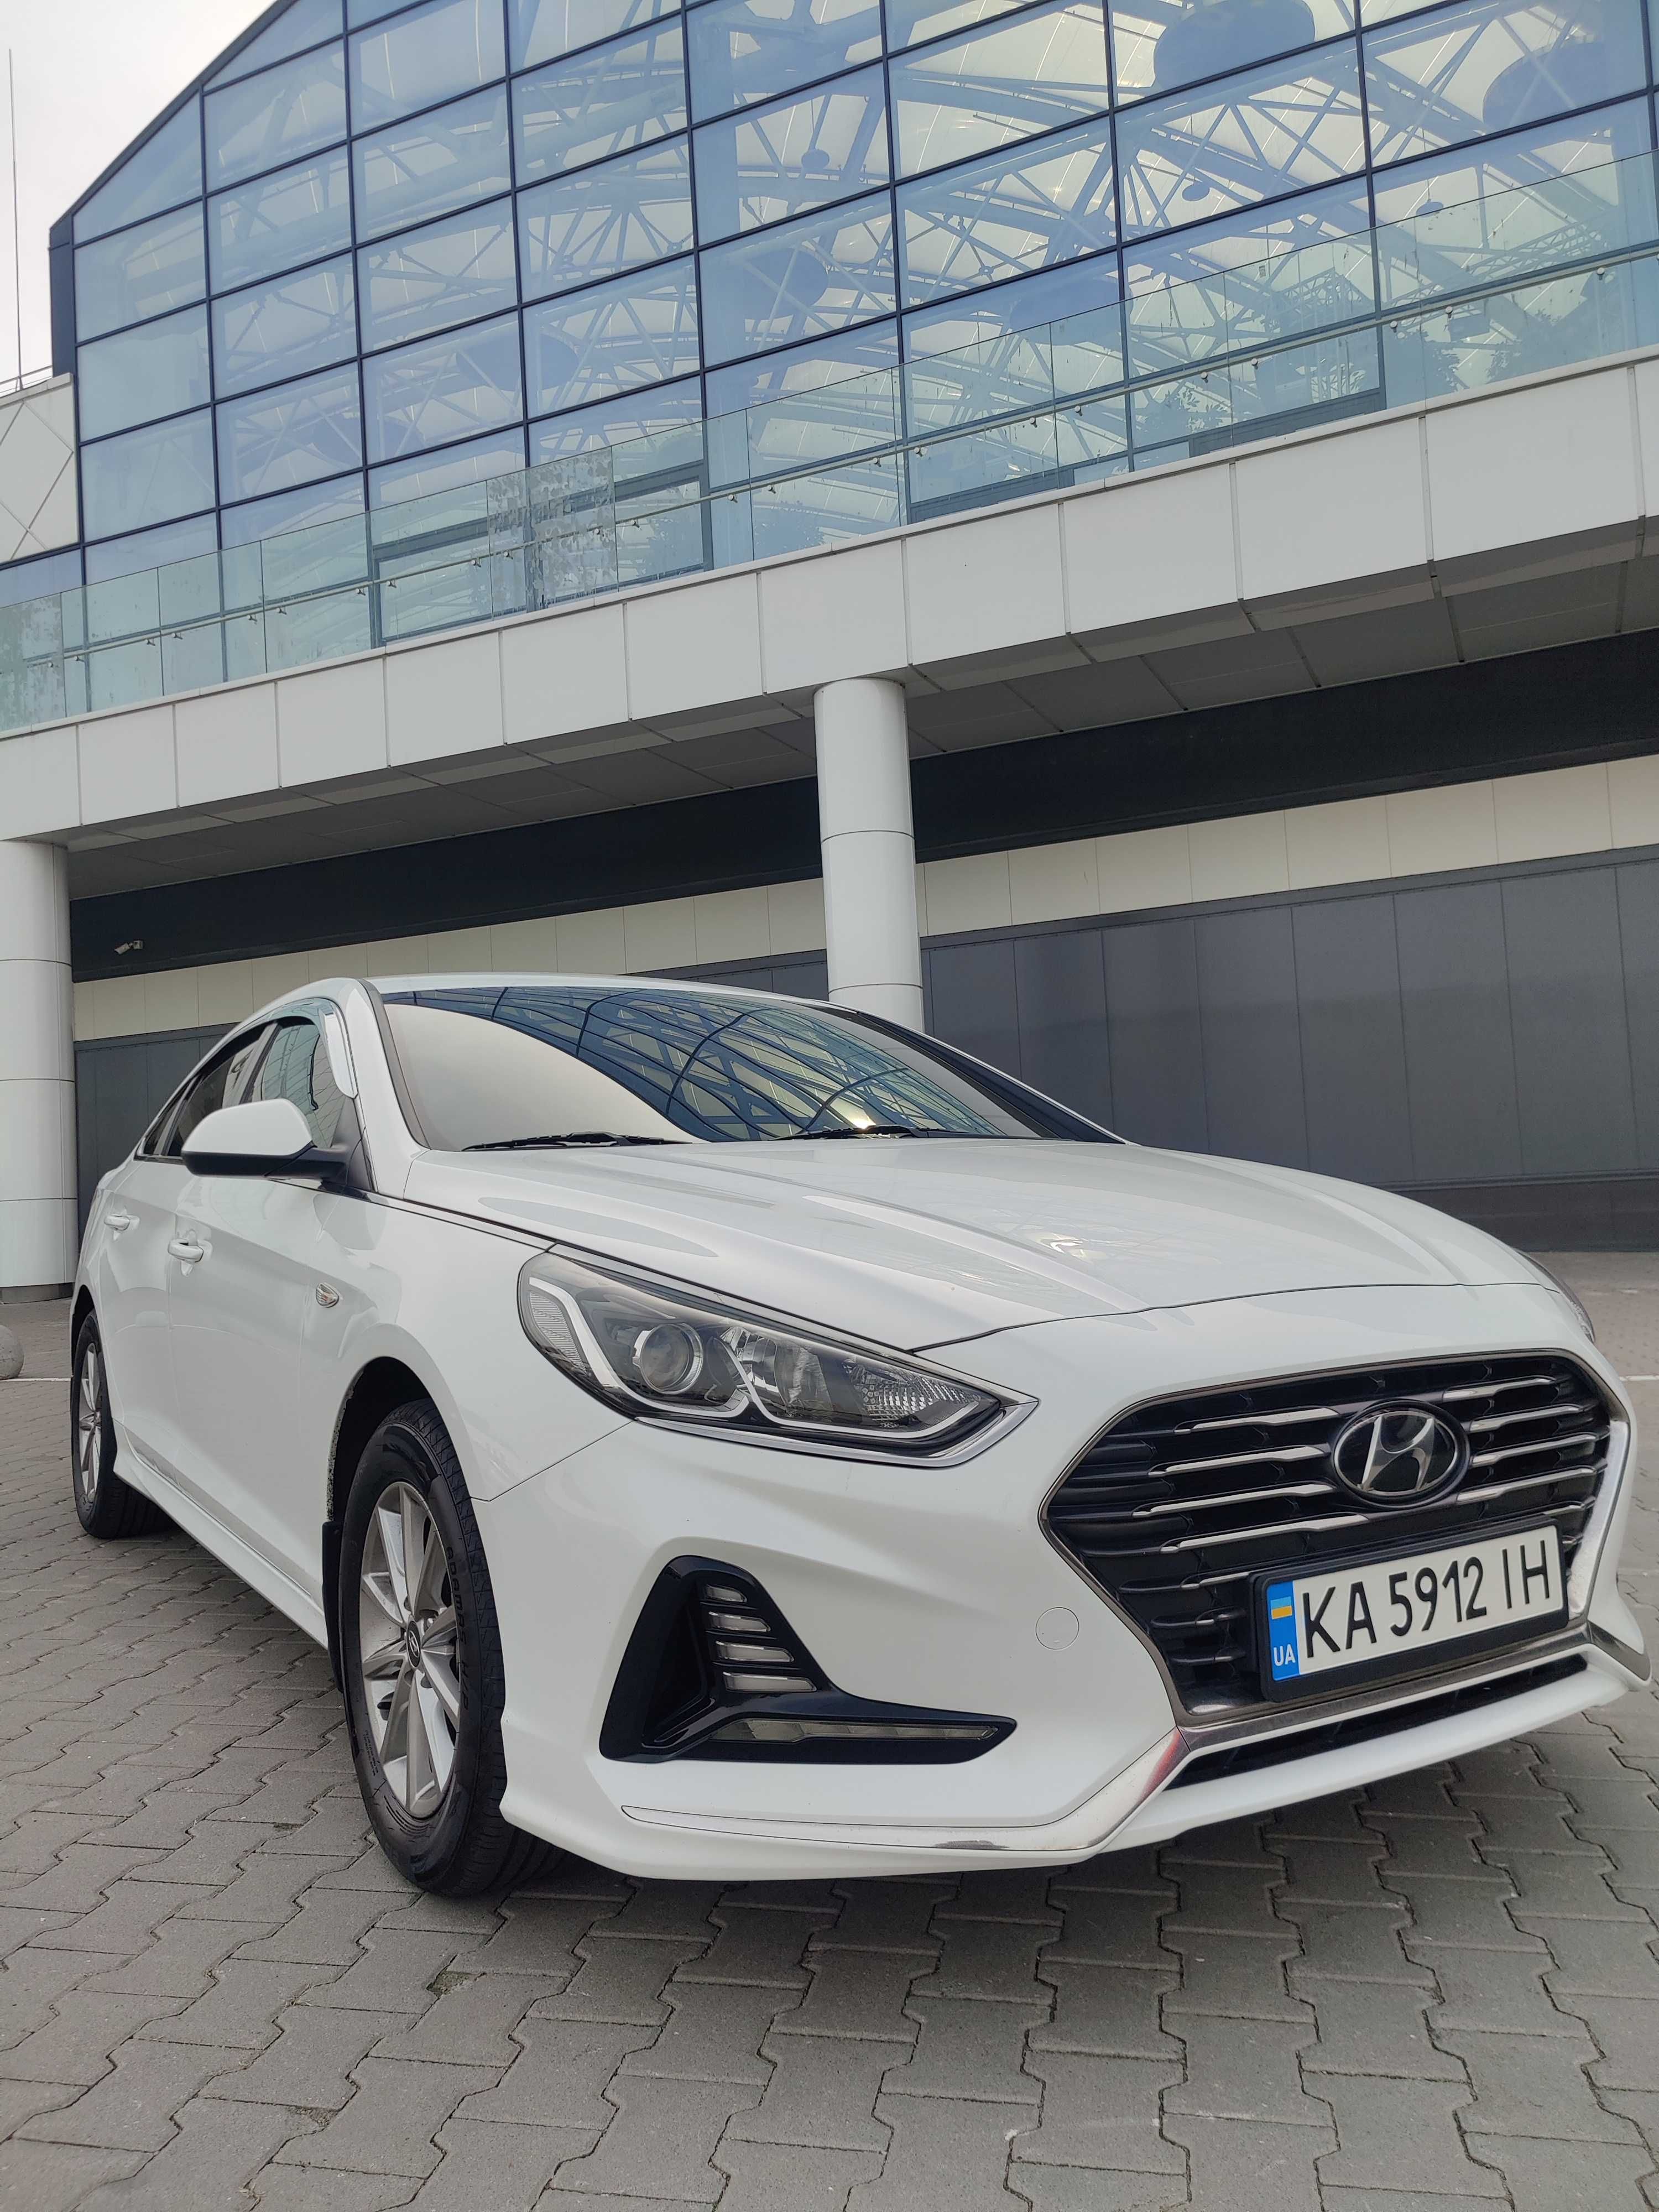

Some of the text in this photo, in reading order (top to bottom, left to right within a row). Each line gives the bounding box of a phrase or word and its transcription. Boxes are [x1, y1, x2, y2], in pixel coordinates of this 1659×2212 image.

[1301, 1540, 1551, 1658] KA 5912 IH
[1273, 1643, 1296, 1667] UA
